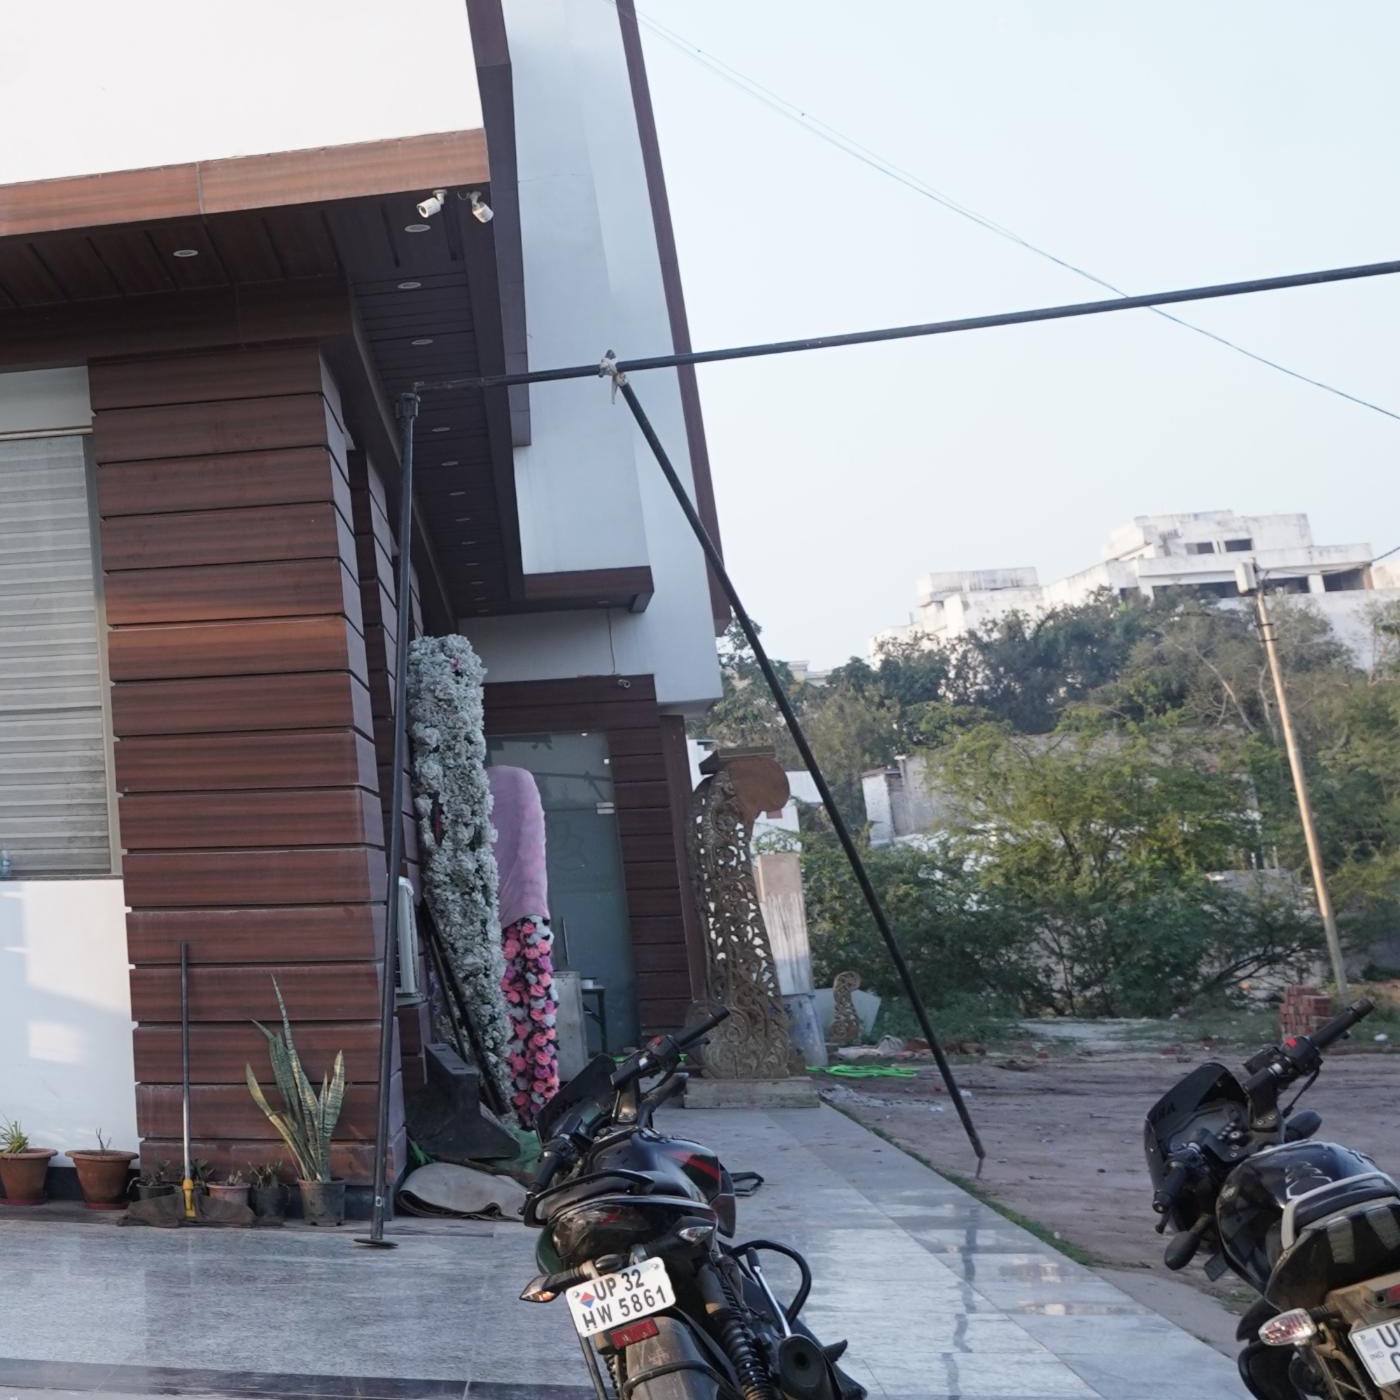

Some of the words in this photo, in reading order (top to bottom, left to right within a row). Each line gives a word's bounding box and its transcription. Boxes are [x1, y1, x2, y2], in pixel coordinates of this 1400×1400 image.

[593, 1277, 617, 1301] UP
[621, 1268, 645, 1292] 32
[582, 1303, 613, 1331] HW
[618, 1284, 666, 1317] 5861
